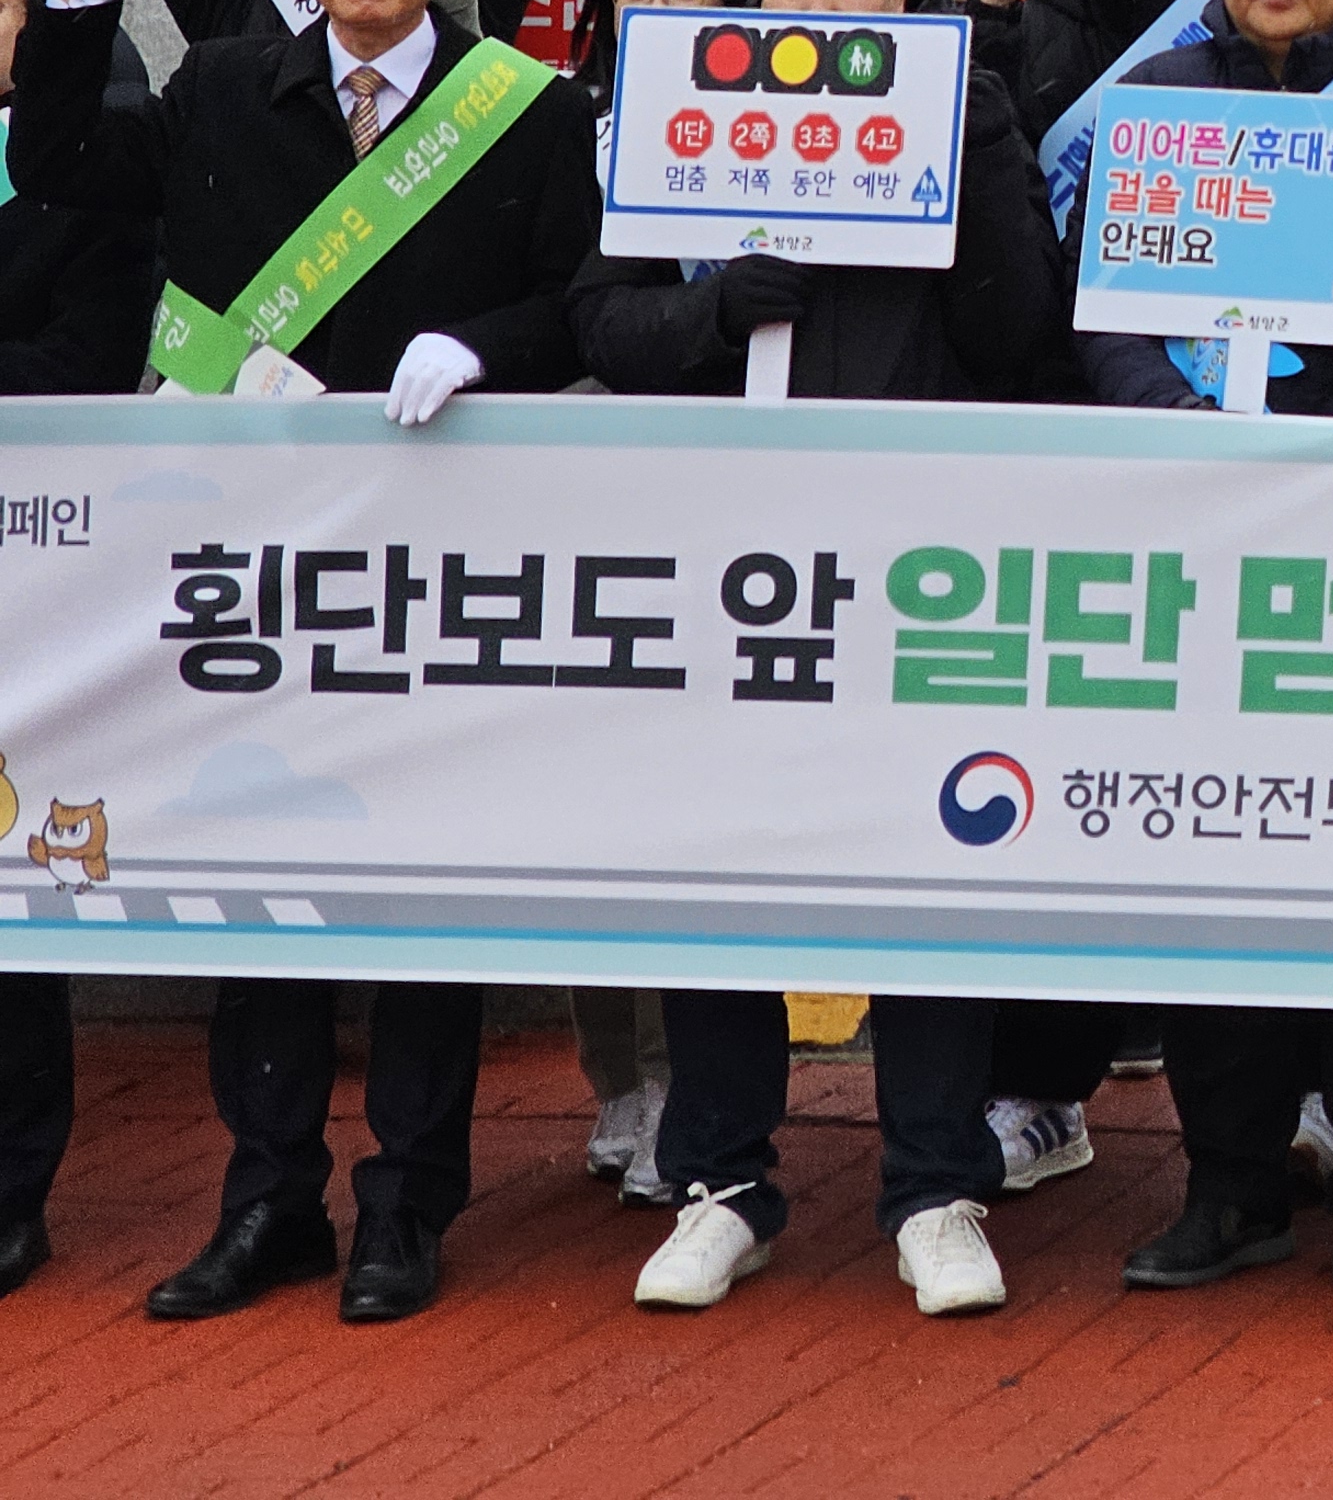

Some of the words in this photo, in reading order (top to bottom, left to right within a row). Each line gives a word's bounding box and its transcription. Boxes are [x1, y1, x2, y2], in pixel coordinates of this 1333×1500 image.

[674, 121, 706, 140] 1단
[735, 123, 771, 150] 2쪽
[797, 124, 835, 150] 3초
[861, 128, 898, 152] 4고
[665, 164, 707, 194] 멈춤
[728, 167, 771, 196] 저쪽
[790, 169, 837, 198] 동안
[853, 172, 901, 200] 예방
[1108, 171, 1182, 216] 걸을
[1195, 175, 1273, 221] 때는
[772, 236, 814, 250] 청양군
[1102, 221, 1215, 265] 안돼요
[1248, 316, 1290, 332] 청양군
[0, 494, 91, 548] 페인
[160, 543, 687, 695] 횡단보도
[720, 551, 856, 704] 앞
[885, 546, 1197, 712] 일단
